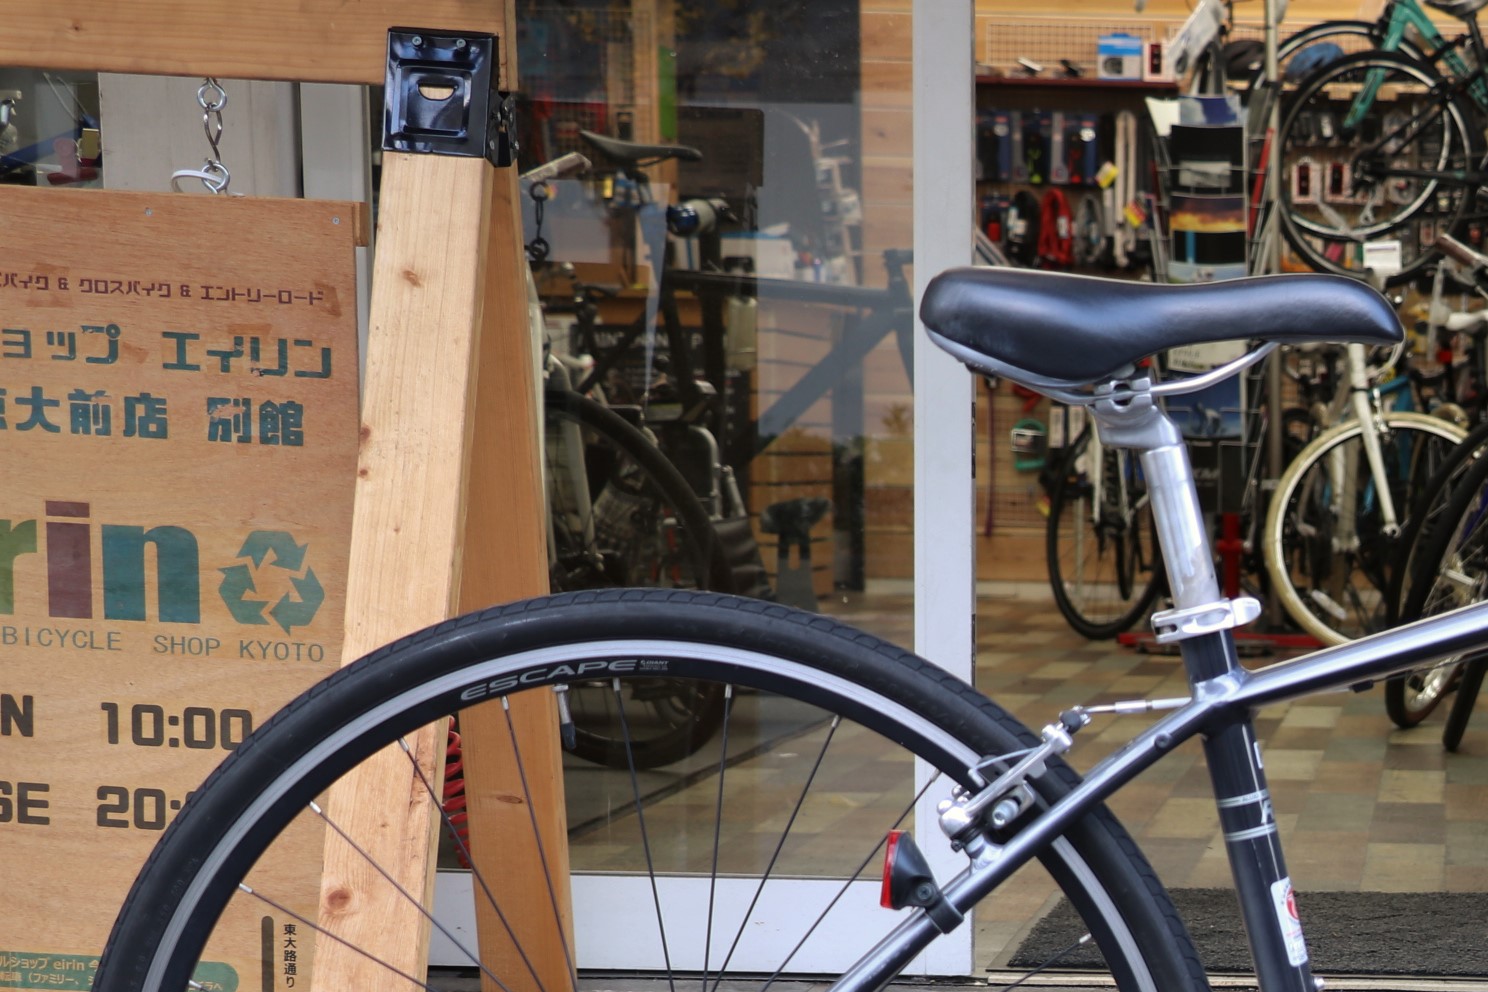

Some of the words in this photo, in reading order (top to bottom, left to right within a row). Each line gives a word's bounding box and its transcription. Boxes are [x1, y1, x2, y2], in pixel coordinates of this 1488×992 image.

[0, 272, 49, 291] バイク
[58, 277, 69, 291] &
[79, 278, 171, 297] クロスバイク
[180, 285, 191, 297] &
[201, 285, 324, 305] エントリーロード
[162, 331, 332, 379] エイリン
[0, 386, 168, 439] 大前店
[206, 397, 304, 447] 別館
[2, 626, 122, 650] BICYCLE
[153, 635, 221, 656] SHOP
[239, 640, 324, 662] KYOTO
[460, 659, 638, 701] ESCAPE
[101, 702, 252, 750] 10:00
[97, 785, 199, 831] 20:
[53, 959, 85, 971] eirin
[283, 923, 297, 988] 東大路通り
